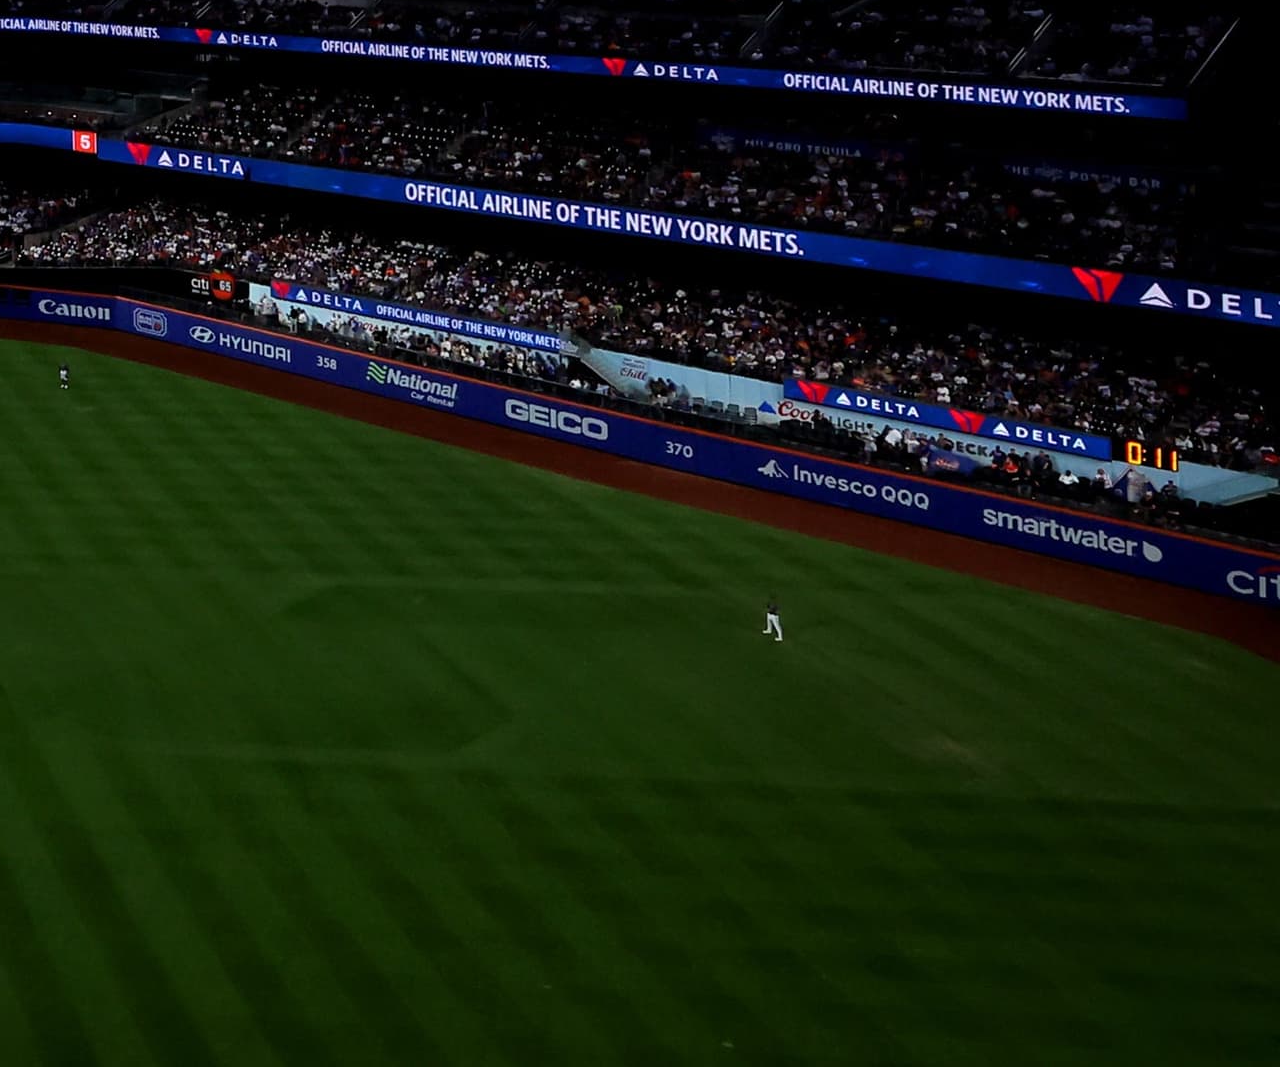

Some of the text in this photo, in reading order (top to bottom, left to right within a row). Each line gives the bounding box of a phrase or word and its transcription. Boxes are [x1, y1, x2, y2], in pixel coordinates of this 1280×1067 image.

[231, 33, 277, 47] DELTA
[321, 40, 366, 54] OFFICIAL
[367, 44, 409, 57] AIRLINE
[411, 47, 426, 58] OF
[427, 48, 449, 60] THE
[451, 50, 478, 63] NEW
[480, 52, 512, 65] YORK
[654, 64, 1130, 112] DELTA OFFICIAL AIRLINE OF THE NEW YORK METS.
[79, 134, 90, 150] 5
[177, 152, 804, 255] DELTA OFFICIAL AIRLINE OF THE NEW YORK METS.
[38, 299, 111, 321] Canon
[311, 291, 362, 311] DELTA
[376, 304, 414, 321] OFFICIAL
[415, 312, 451, 329] AIRLINE
[451, 319, 464, 330] OF
[465, 321, 483, 334] THE
[484, 325, 506, 340] NEW
[507, 329, 535, 344] YORK
[1187, 288, 1280, 319] DEL
[219, 333, 291, 363] HYUNDAI
[316, 355, 337, 370] 358
[386, 368, 458, 399] National
[410, 391, 455, 408] Car Rental
[777, 400, 824, 423] Coo
[856, 395, 919, 418] DELTA
[505, 399, 608, 440] GEICO
[665, 441, 694, 459] 370
[1015, 426, 1085, 450] DELTA
[1126, 441, 1179, 472] 0:11
[793, 464, 929, 510] Invesco QQQ
[983, 508, 1138, 556] smartwater
